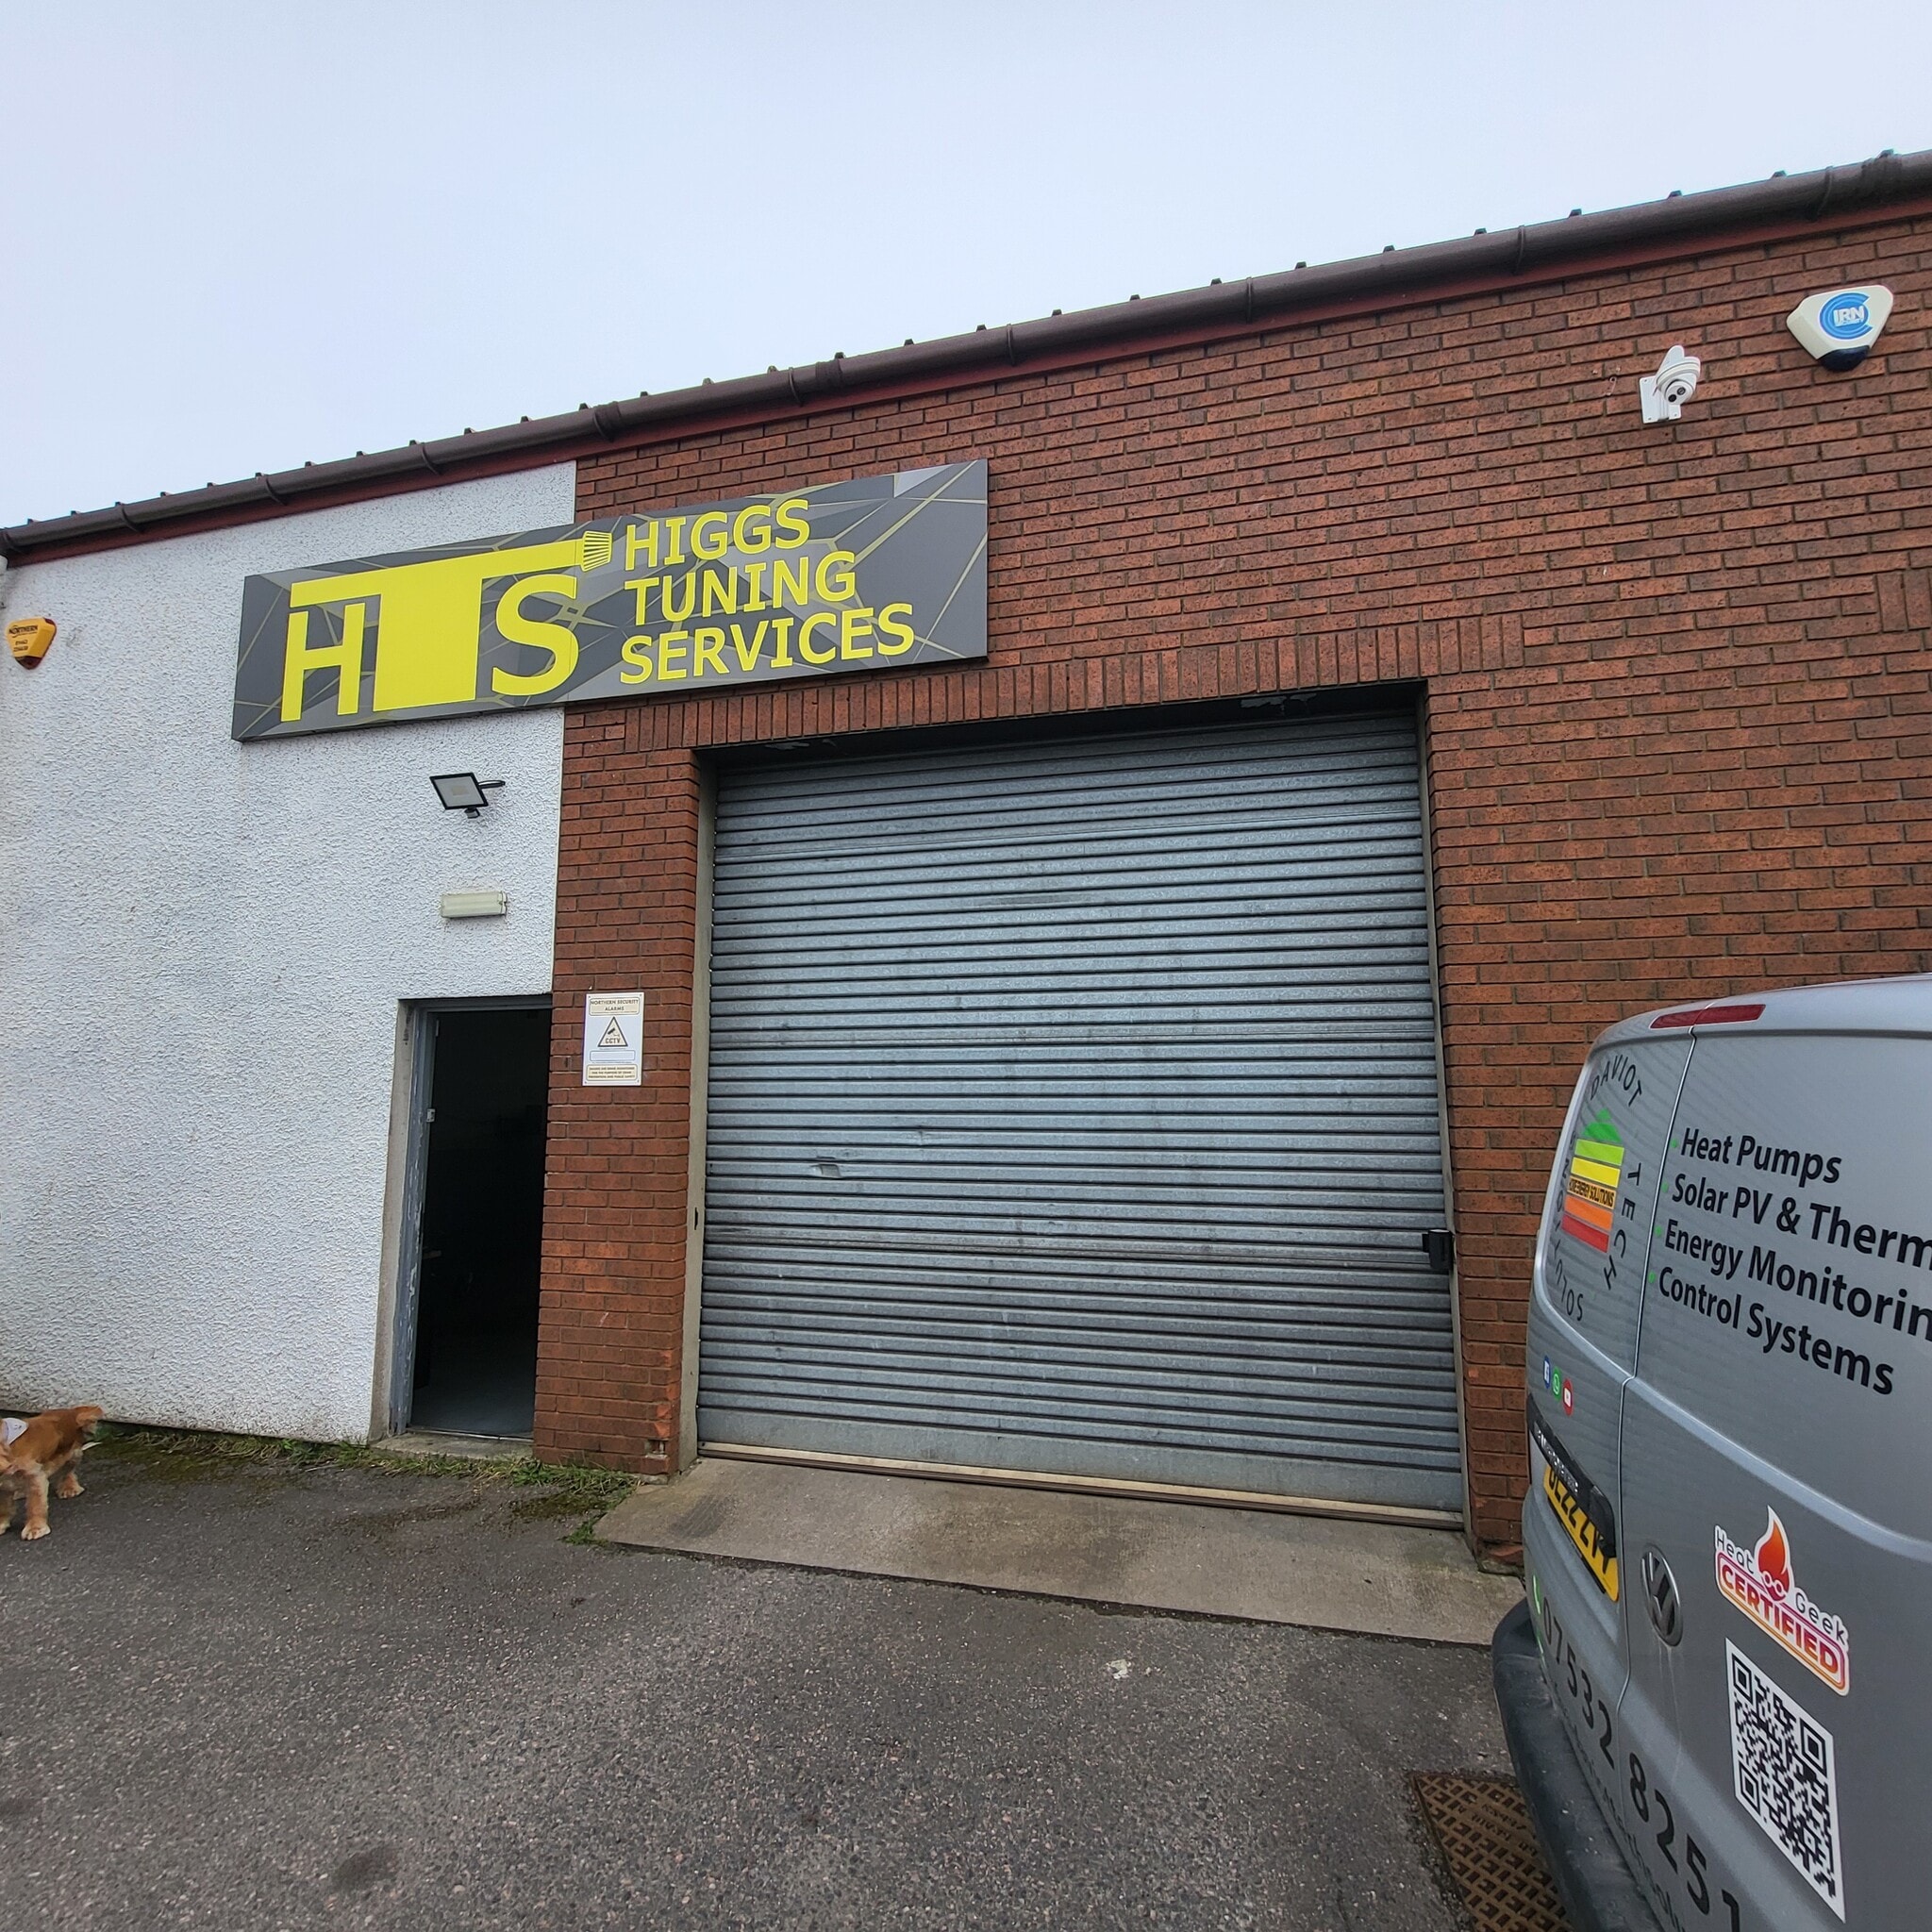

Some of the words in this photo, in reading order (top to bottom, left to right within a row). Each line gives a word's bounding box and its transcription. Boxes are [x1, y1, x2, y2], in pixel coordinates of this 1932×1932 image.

[625, 499, 810, 572] HIGGS
[624, 550, 856, 626] TUNING
[620, 603, 915, 685] SERVICES
[1590, 1055, 1642, 1108] DAVIOT
[1680, 1127, 1733, 1164] Heat
[1736, 1135, 1842, 1188] Pumps
[1604, 1162, 1641, 1291] TECH
[1672, 1173, 1729, 1214] Solar
[1732, 1186, 1774, 1225] PV
[1775, 1197, 1802, 1235] &
[1809, 1202, 1932, 1272] Therm
[1658, 1266, 1742, 1329] Control
[1746, 1303, 1894, 1395] Systems
[1664, 1219, 1744, 1280] Energy
[1747, 1245, 1932, 1342] Monitorin
[1716, 1528, 1755, 1574] Heat
[1795, 1591, 1846, 1646] Geek
[1722, 1564, 1839, 1674] CERTIFIED
[1543, 1596, 1615, 1770] 07532
